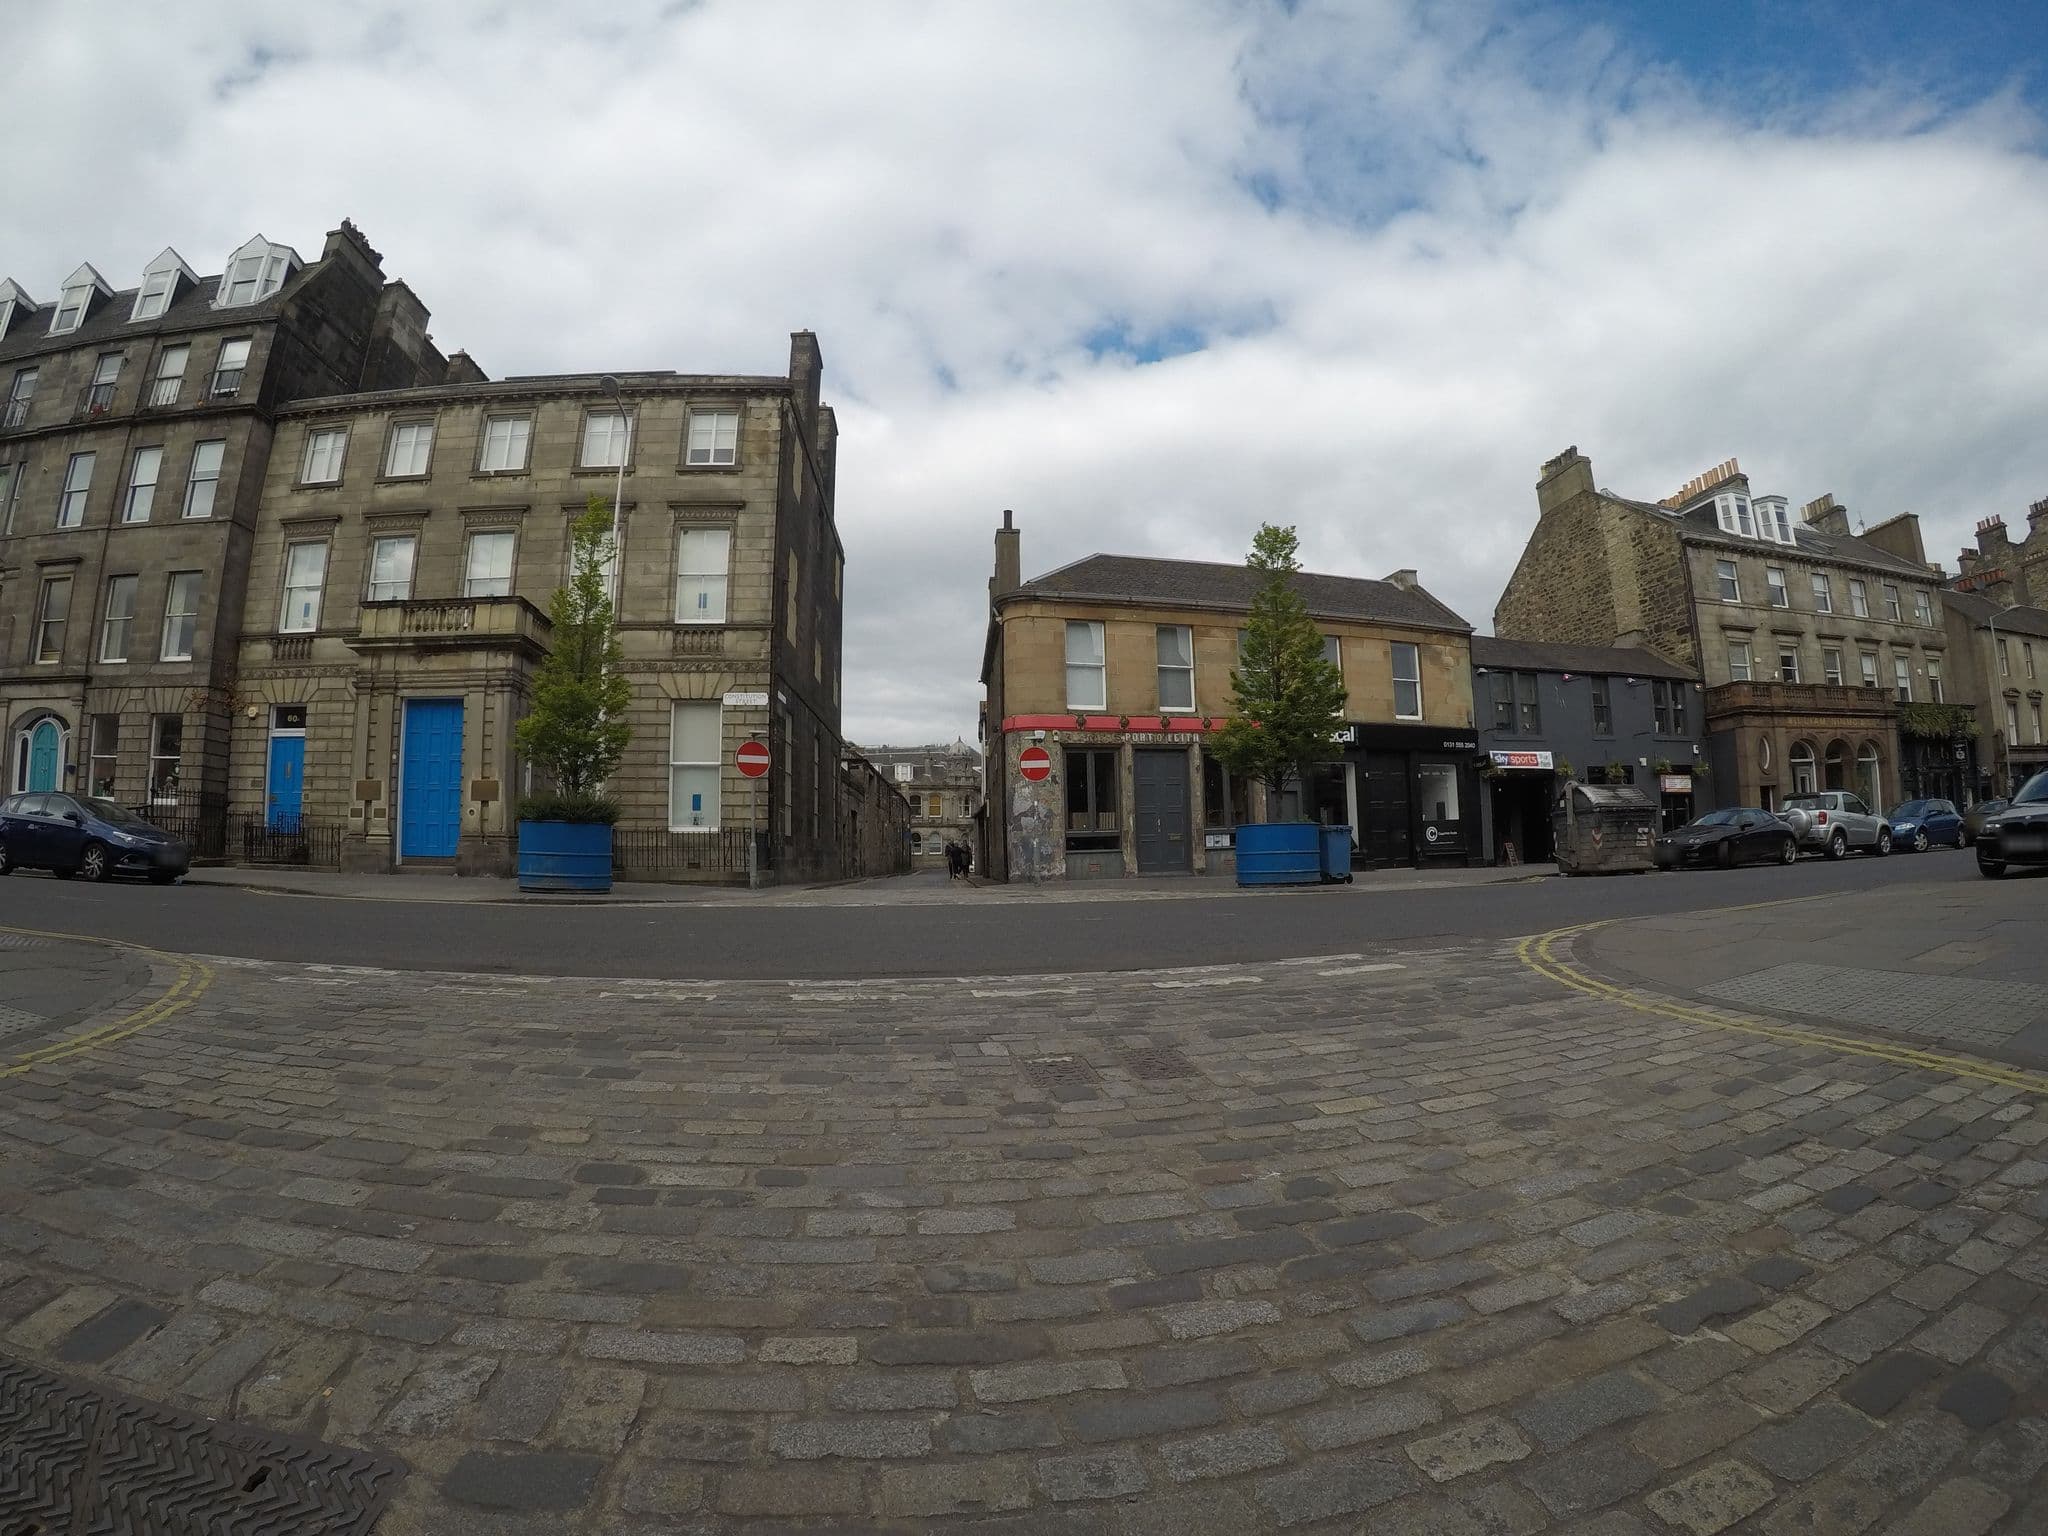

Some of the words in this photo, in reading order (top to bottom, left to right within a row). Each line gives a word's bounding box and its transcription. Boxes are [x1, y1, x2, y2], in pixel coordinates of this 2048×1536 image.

[1125, 733, 1152, 742] PORT
[1167, 733, 1200, 742] LEITH
[1494, 754, 1508, 765] sky
[1509, 755, 1537, 765] sports
